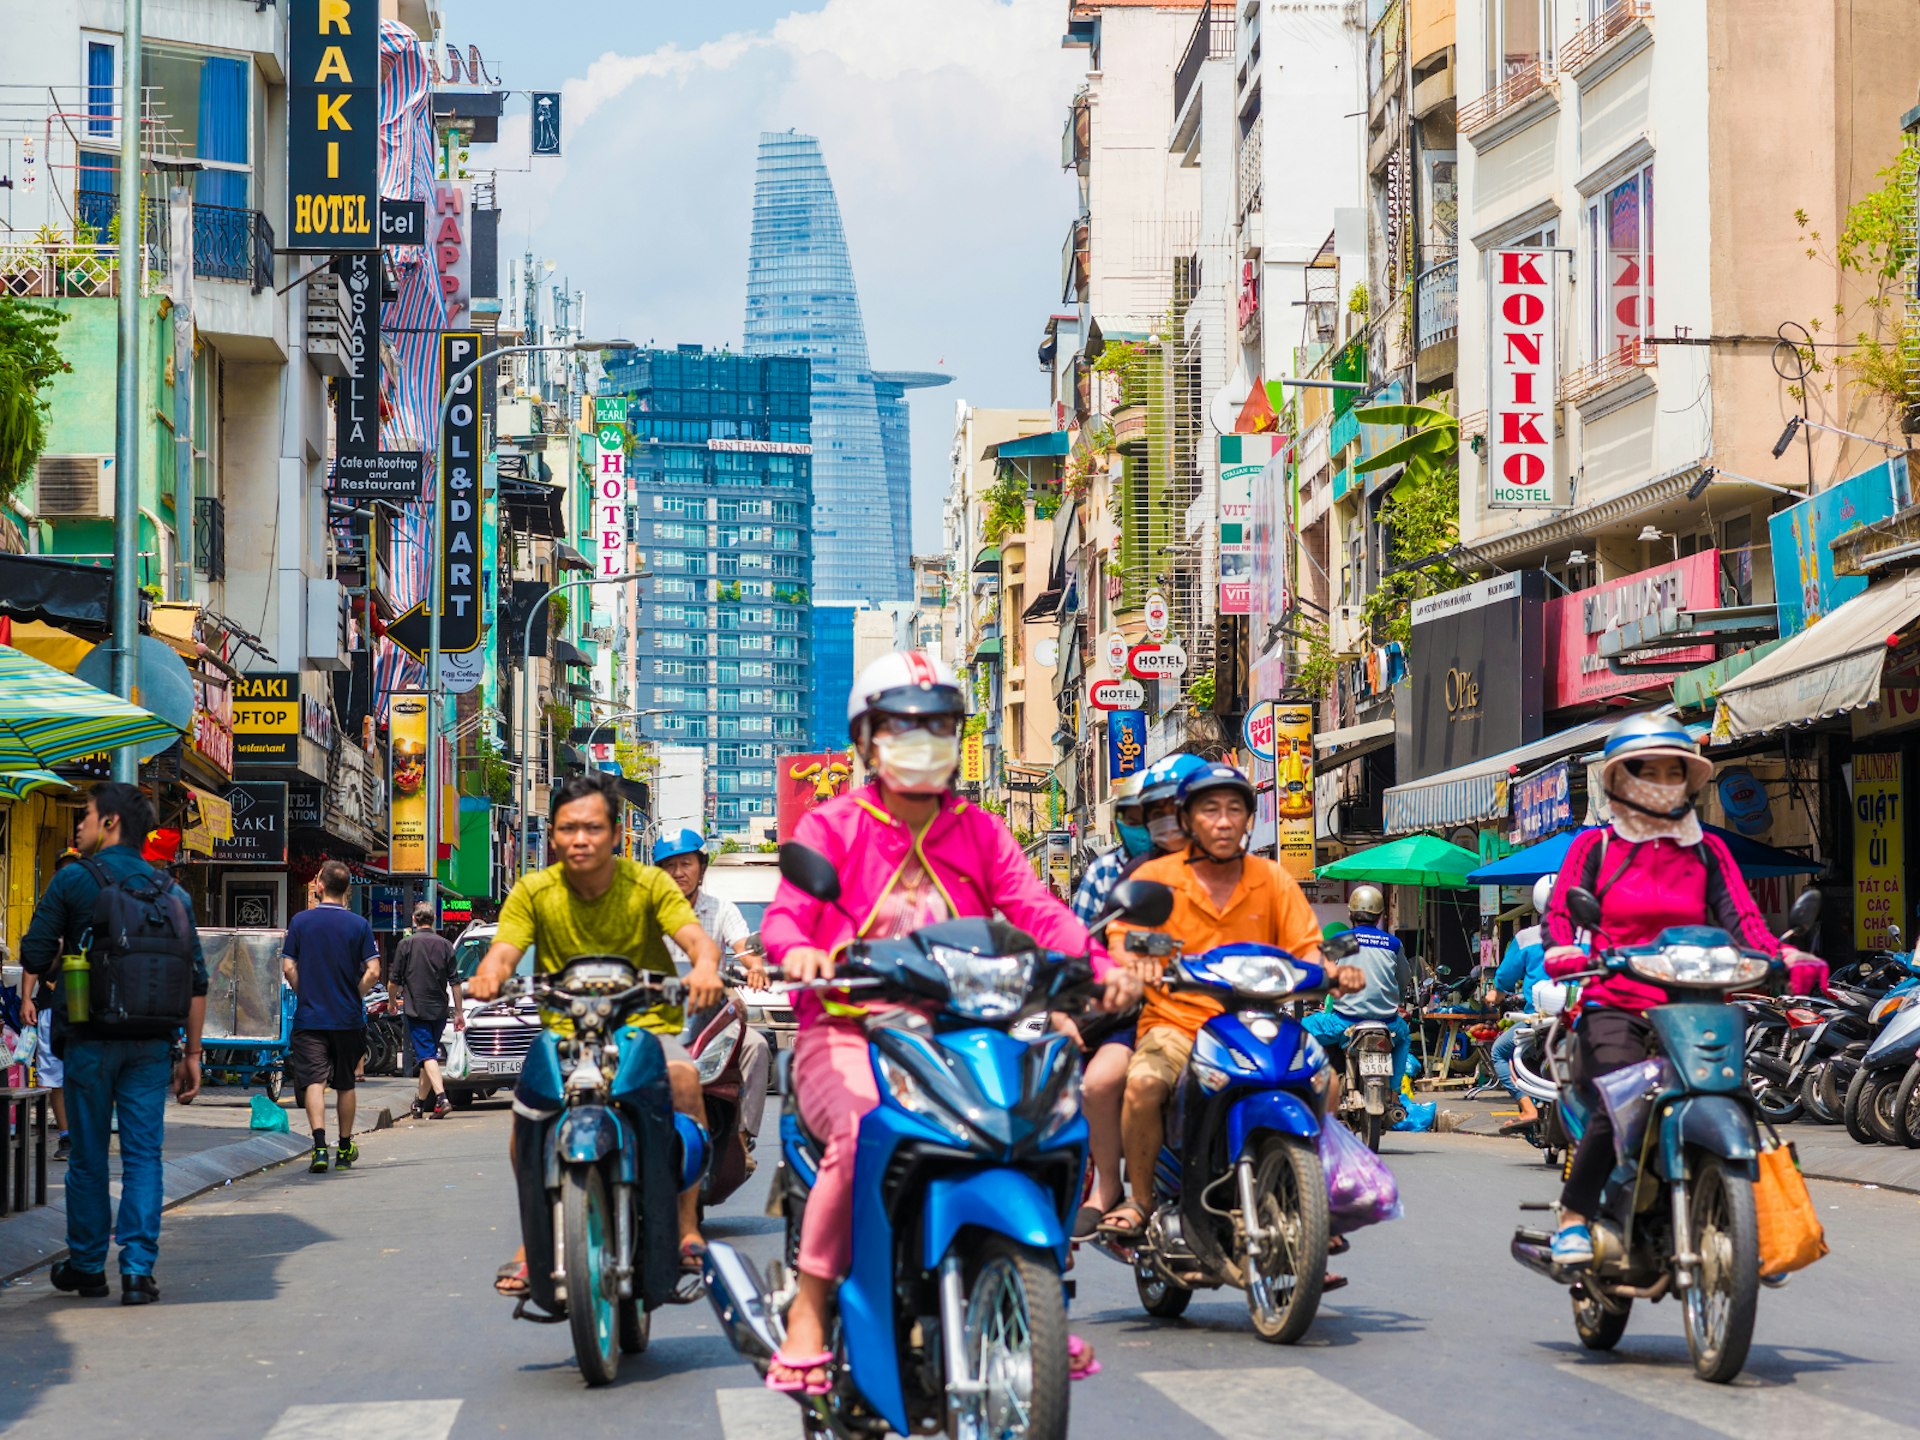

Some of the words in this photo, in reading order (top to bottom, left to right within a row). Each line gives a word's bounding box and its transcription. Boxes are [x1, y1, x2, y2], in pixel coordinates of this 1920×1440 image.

[295, 194, 370, 234] HOTEL
[382, 211, 413, 233] tel
[1499, 252, 1548, 486] KONIKO
[605, 400, 618, 409] VN
[597, 410, 625, 420] PEARL
[600, 430, 621, 445] 94
[711, 440, 733, 450] BEN
[734, 441, 778, 453] THANH
[780, 442, 812, 454] LAND
[340, 456, 362, 468] Cafe
[364, 459, 377, 468] on
[378, 456, 418, 472] Rooftop
[368, 470, 388, 479] and
[341, 478, 416, 491] Restaurant
[1495, 488, 1551, 501] HOSTEL
[601, 454, 622, 575] HOTEL
[1139, 656, 1183, 665] HOTEL
[232, 679, 288, 697] ERAKI
[1100, 690, 1140, 699] HOTEL
[234, 711, 287, 725] OFTOP
[1250, 715, 1273, 733] BUR
[1253, 727, 1271, 748] KI
[237, 742, 286, 753] restaurant
[1855, 752, 1899, 782] LAUNDRY
[289, 793, 314, 807] TEL
[288, 809, 317, 821] ATION
[1857, 788, 1898, 829] GIẶT
[232, 814, 275, 831] RAKI
[1858, 874, 1880, 893] TẤT
[1867, 895, 1890, 912] CÁC
